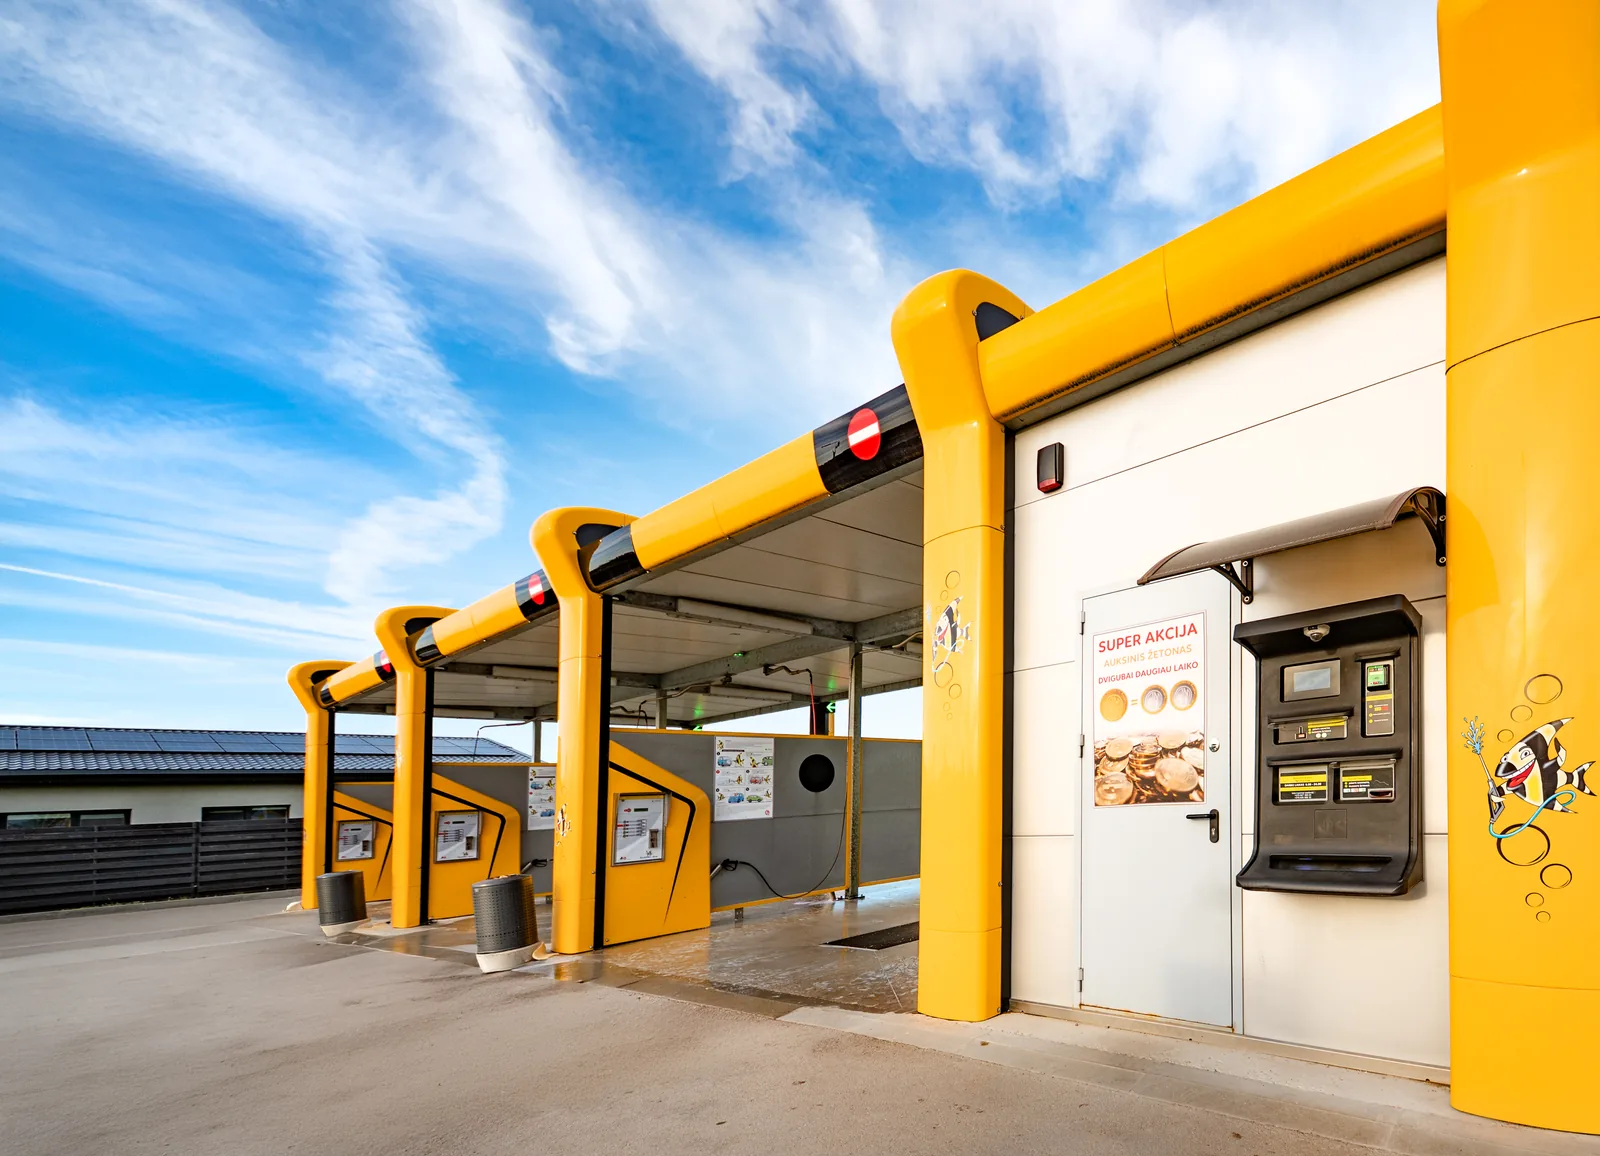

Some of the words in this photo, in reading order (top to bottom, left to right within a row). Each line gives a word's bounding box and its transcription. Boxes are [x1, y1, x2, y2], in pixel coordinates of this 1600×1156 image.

[1098, 634, 1141, 653] SUPER
[1145, 623, 1198, 644] AKCIJA
[1104, 653, 1145, 667] AUKSINIS
[1147, 644, 1192, 660] ŽETONAS
[1098, 672, 1134, 684] DVIGUBAI
[1135, 665, 1172, 678] DAUGIAU
[1174, 661, 1199, 672] LAIKO
